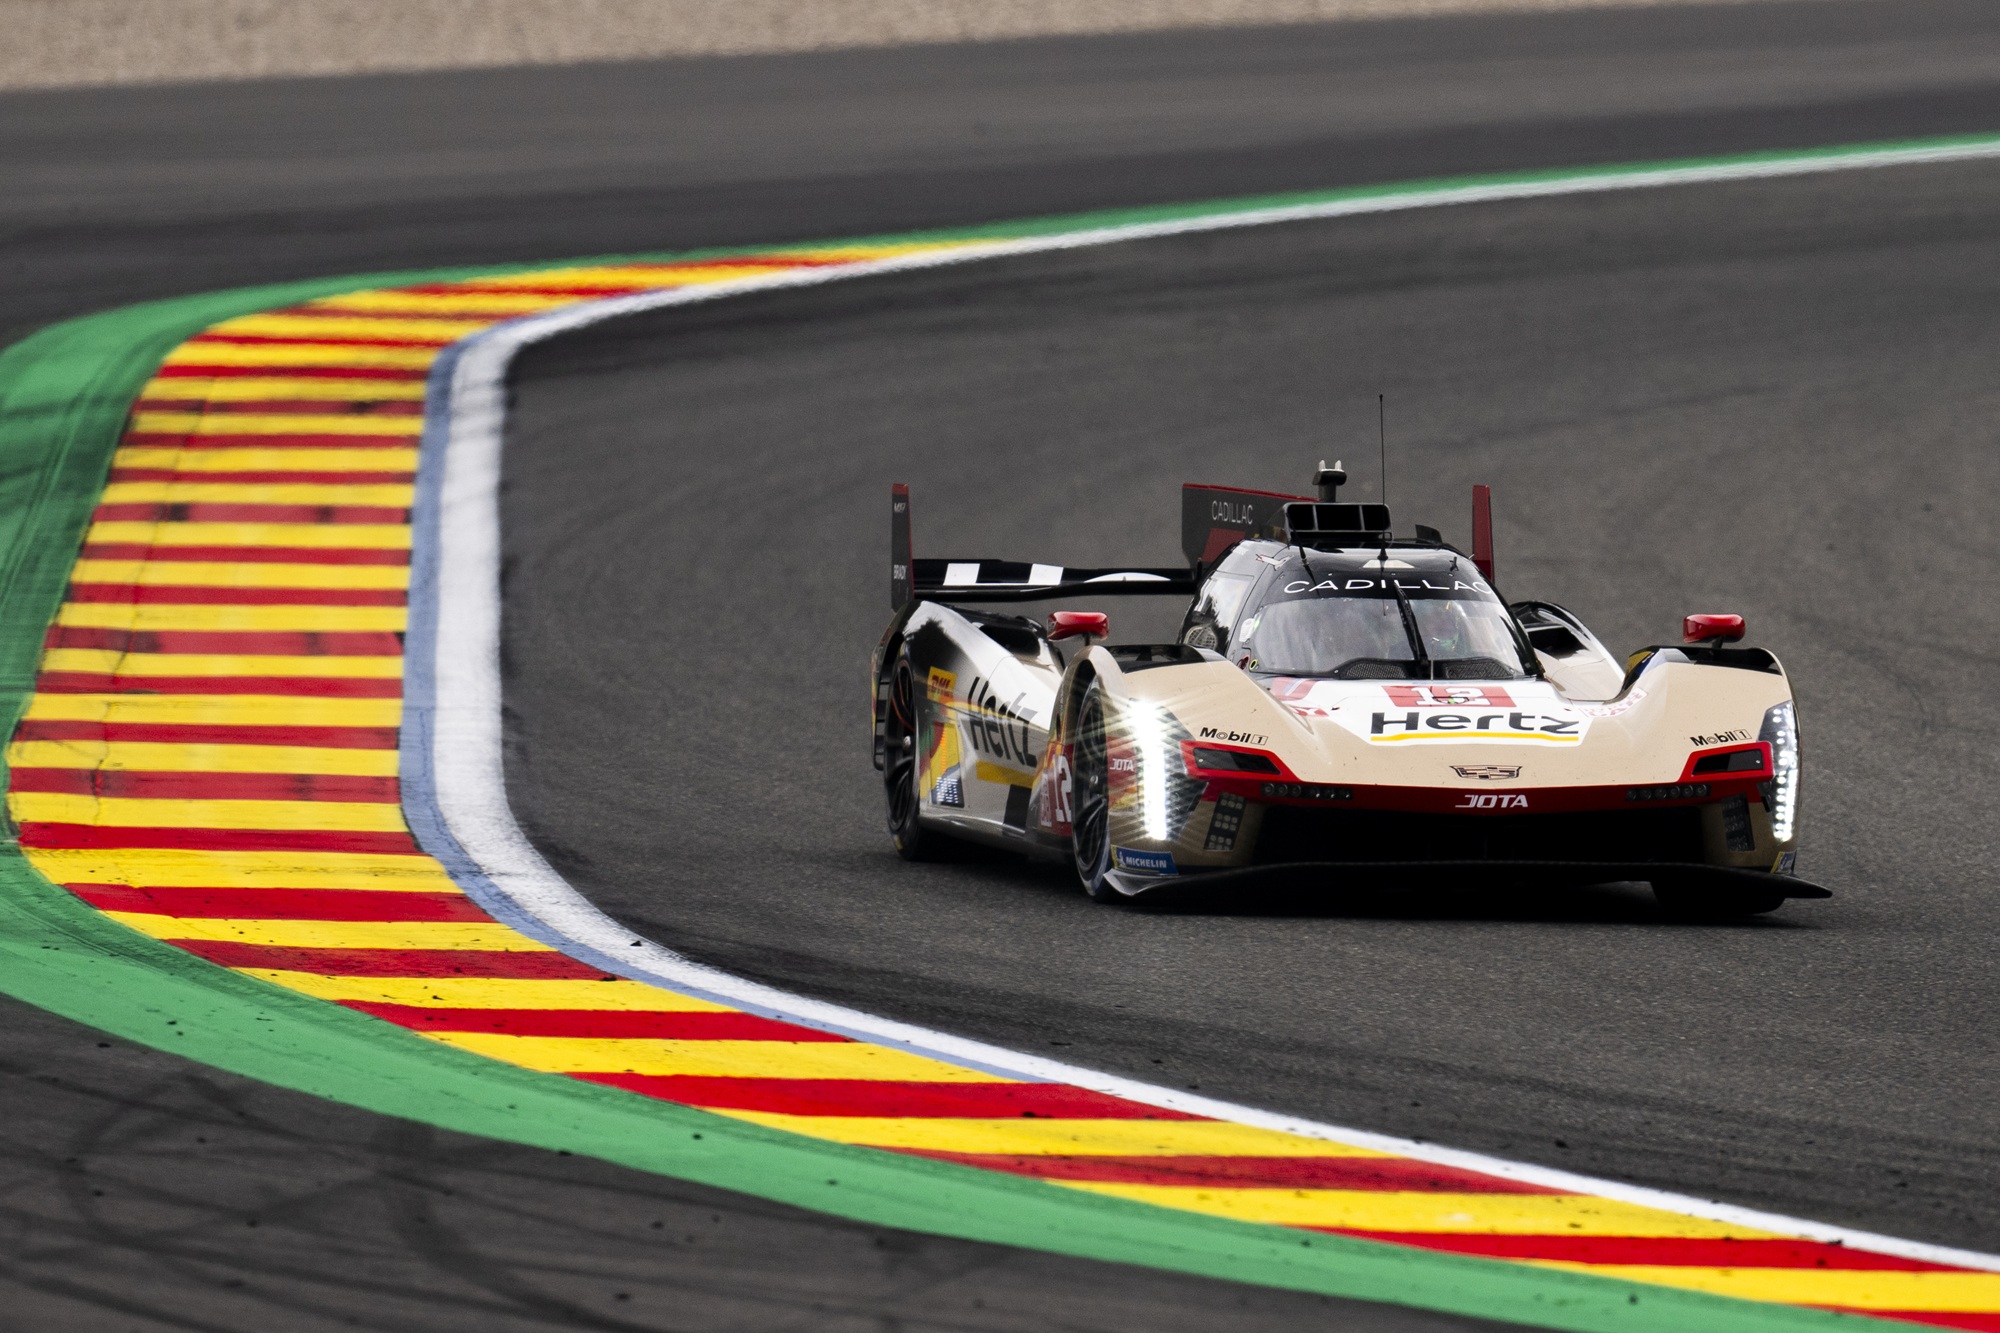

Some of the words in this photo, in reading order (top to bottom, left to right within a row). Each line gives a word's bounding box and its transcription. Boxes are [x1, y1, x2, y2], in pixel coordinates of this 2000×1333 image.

[1212, 500, 1253, 525] CADILLAC
[1283, 579, 1493, 595] CADILLAC
[1410, 686, 1491, 706] 12
[1370, 712, 1580, 734] Hertz
[1199, 727, 1252, 743] Mobil
[1689, 731, 1738, 746] Mobil
[1110, 758, 1135, 772] JOTA
[1455, 794, 1529, 809] JOTA
[1125, 856, 1168, 869] MICHELIN
